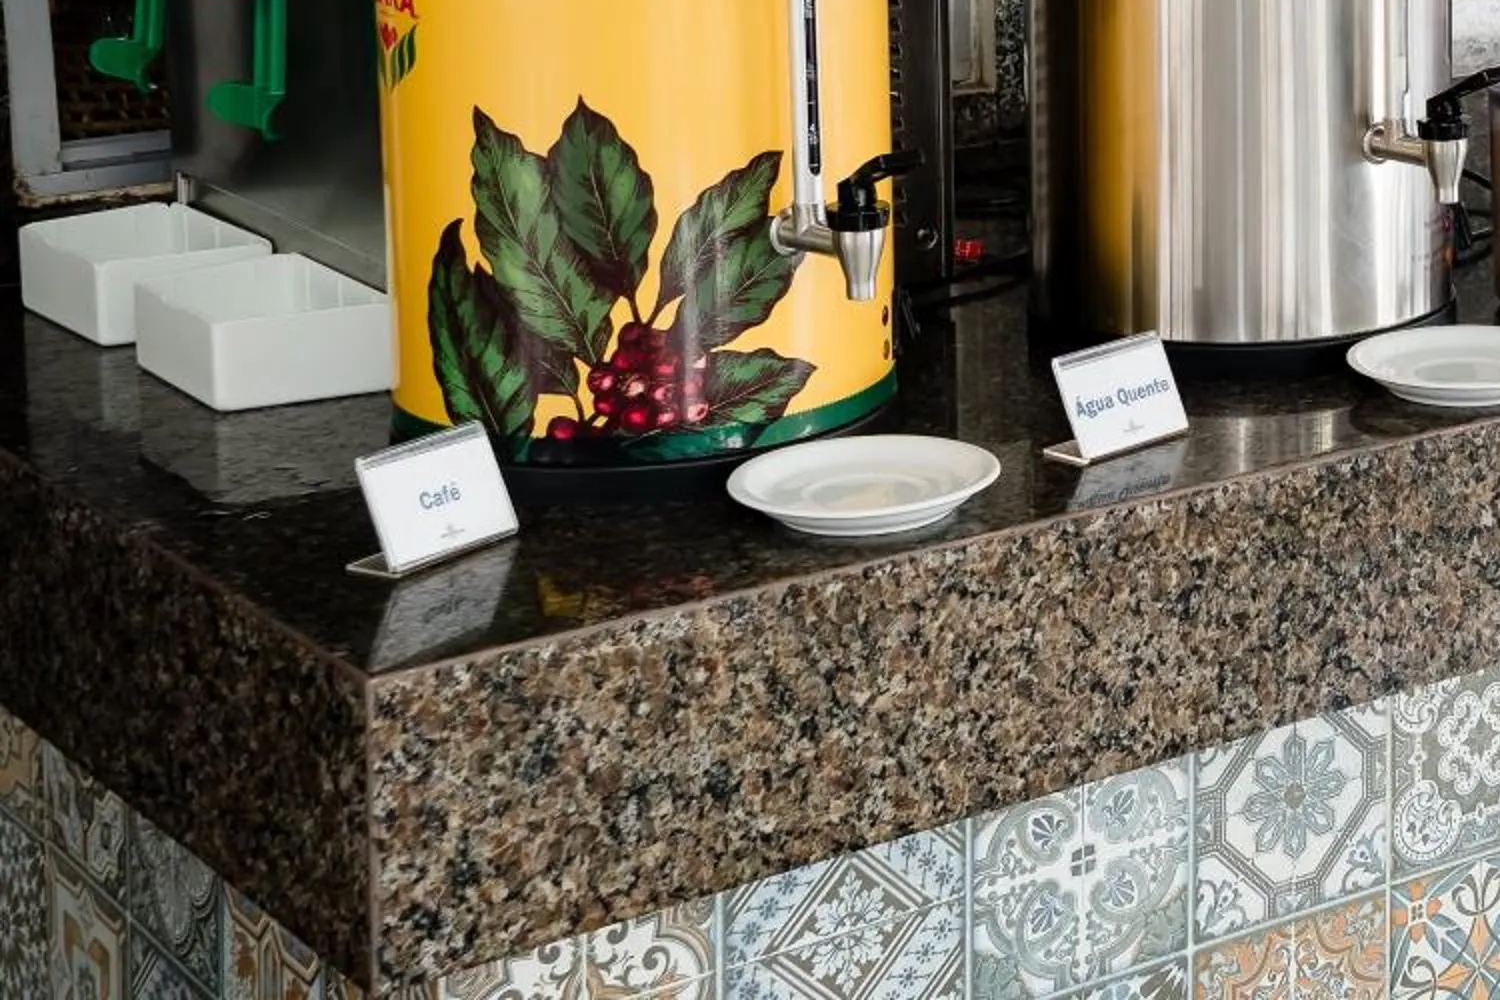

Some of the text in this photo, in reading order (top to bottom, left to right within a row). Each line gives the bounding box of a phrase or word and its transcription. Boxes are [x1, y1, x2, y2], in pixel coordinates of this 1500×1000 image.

[1075, 377, 1171, 419] Água Quente
[418, 482, 462, 510] Café
